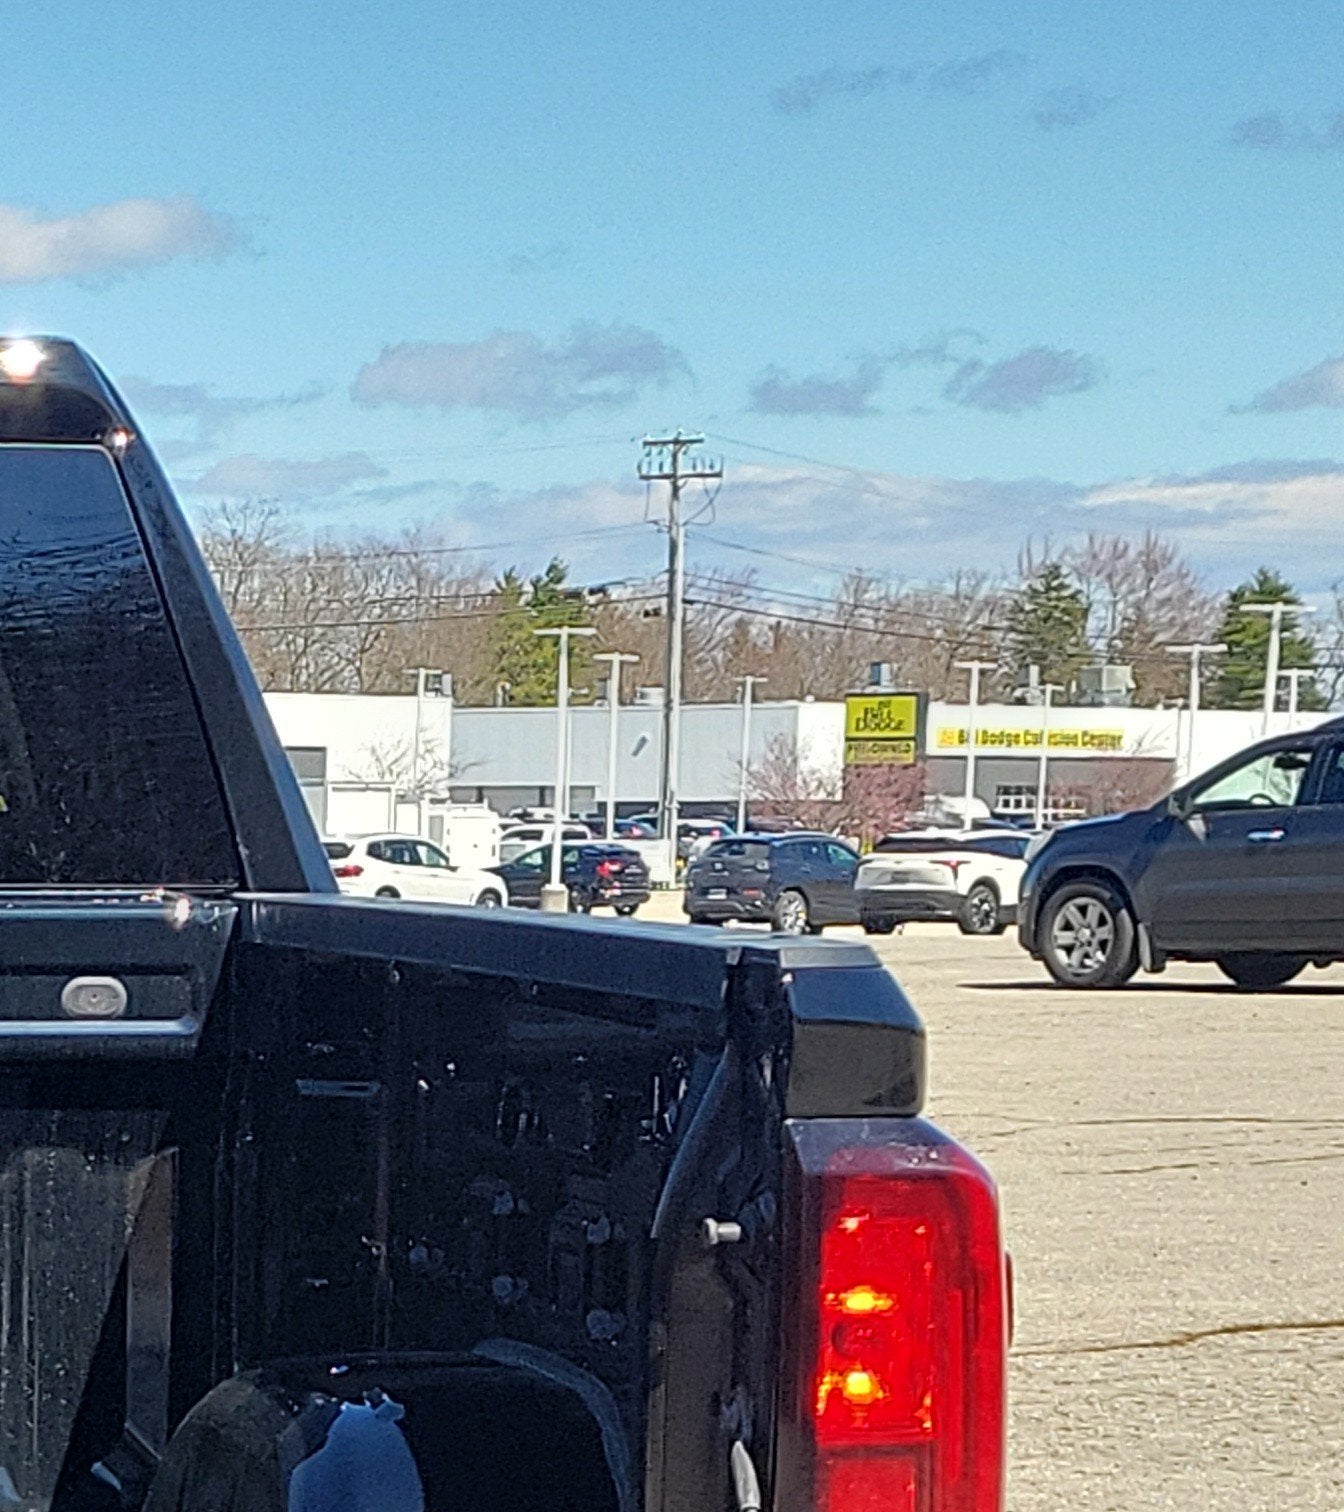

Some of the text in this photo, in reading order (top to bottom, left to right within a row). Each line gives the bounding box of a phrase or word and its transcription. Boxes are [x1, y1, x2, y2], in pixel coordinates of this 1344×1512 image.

[958, 728, 979, 745] Bil
[981, 729, 1021, 748] Dodge
[1023, 729, 1079, 746] Colision
